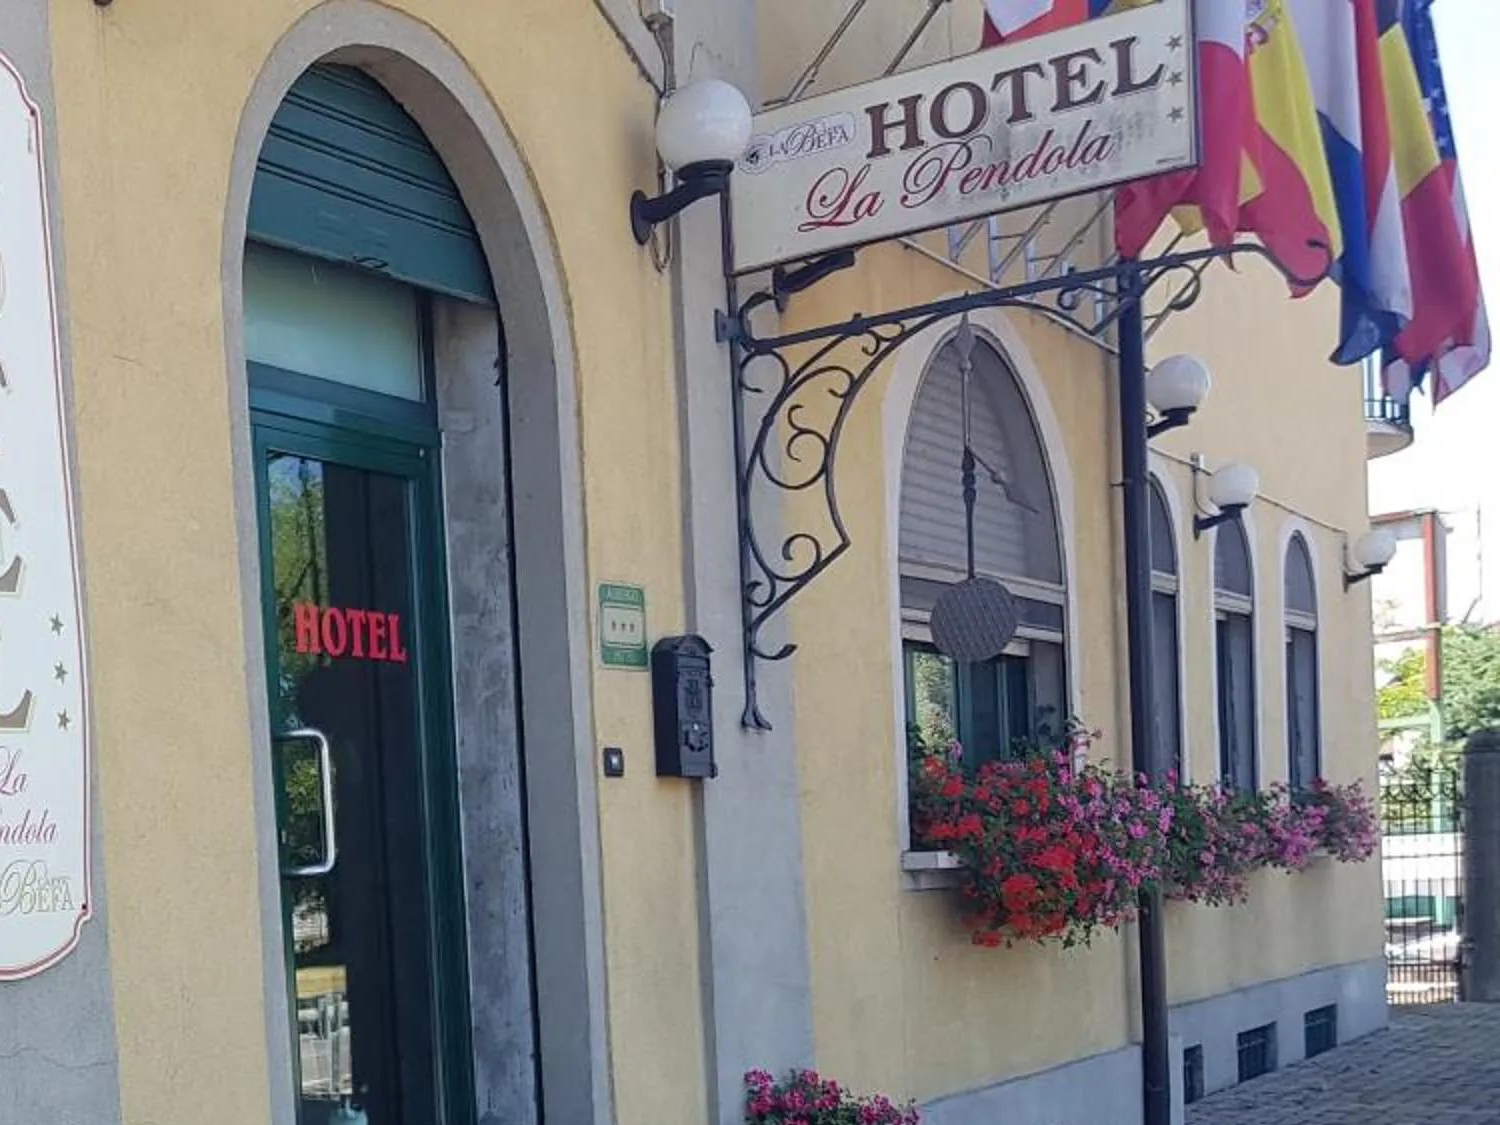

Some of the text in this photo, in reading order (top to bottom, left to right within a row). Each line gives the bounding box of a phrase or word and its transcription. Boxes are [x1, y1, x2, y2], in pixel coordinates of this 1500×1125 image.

[865, 35, 1164, 159] HOTEL
[797, 119, 1114, 232] La Pendola
[293, 600, 408, 663] HOTEL
